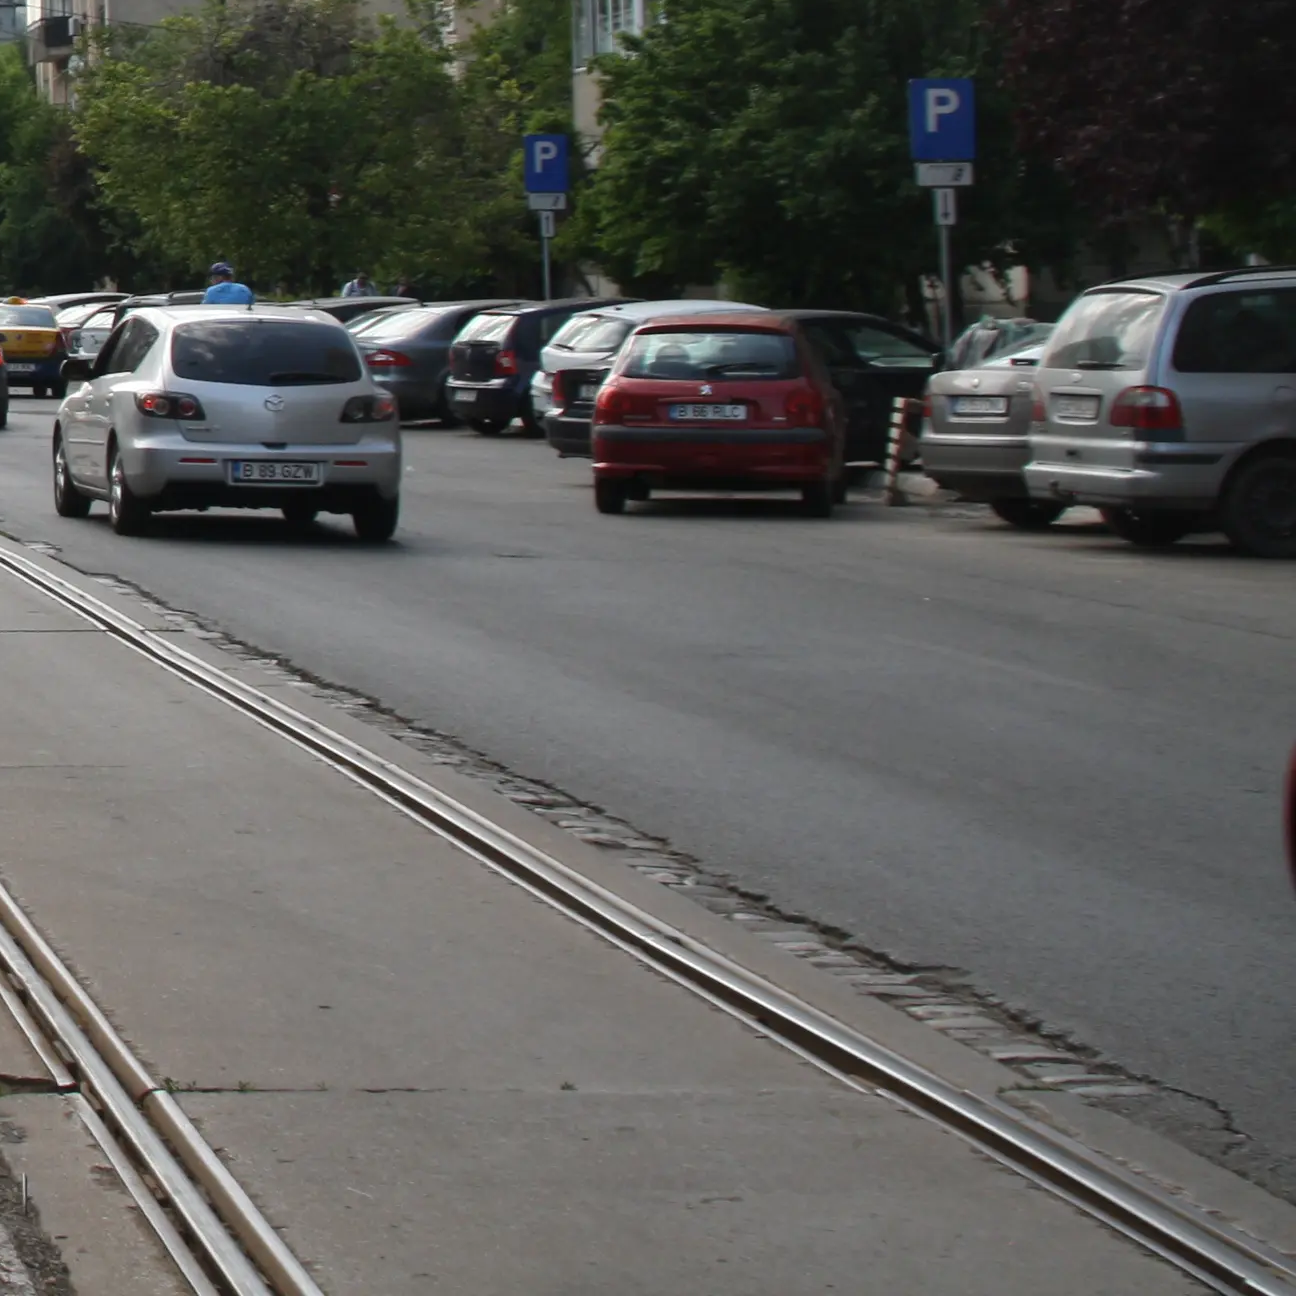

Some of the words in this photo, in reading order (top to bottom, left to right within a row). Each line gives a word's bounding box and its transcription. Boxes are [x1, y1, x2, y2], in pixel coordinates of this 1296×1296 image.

[926, 88, 960, 133] P
[534, 140, 558, 173] P
[679, 405, 688, 417] B
[242, 464, 253, 478] B
[281, 465, 314, 479] GZW
